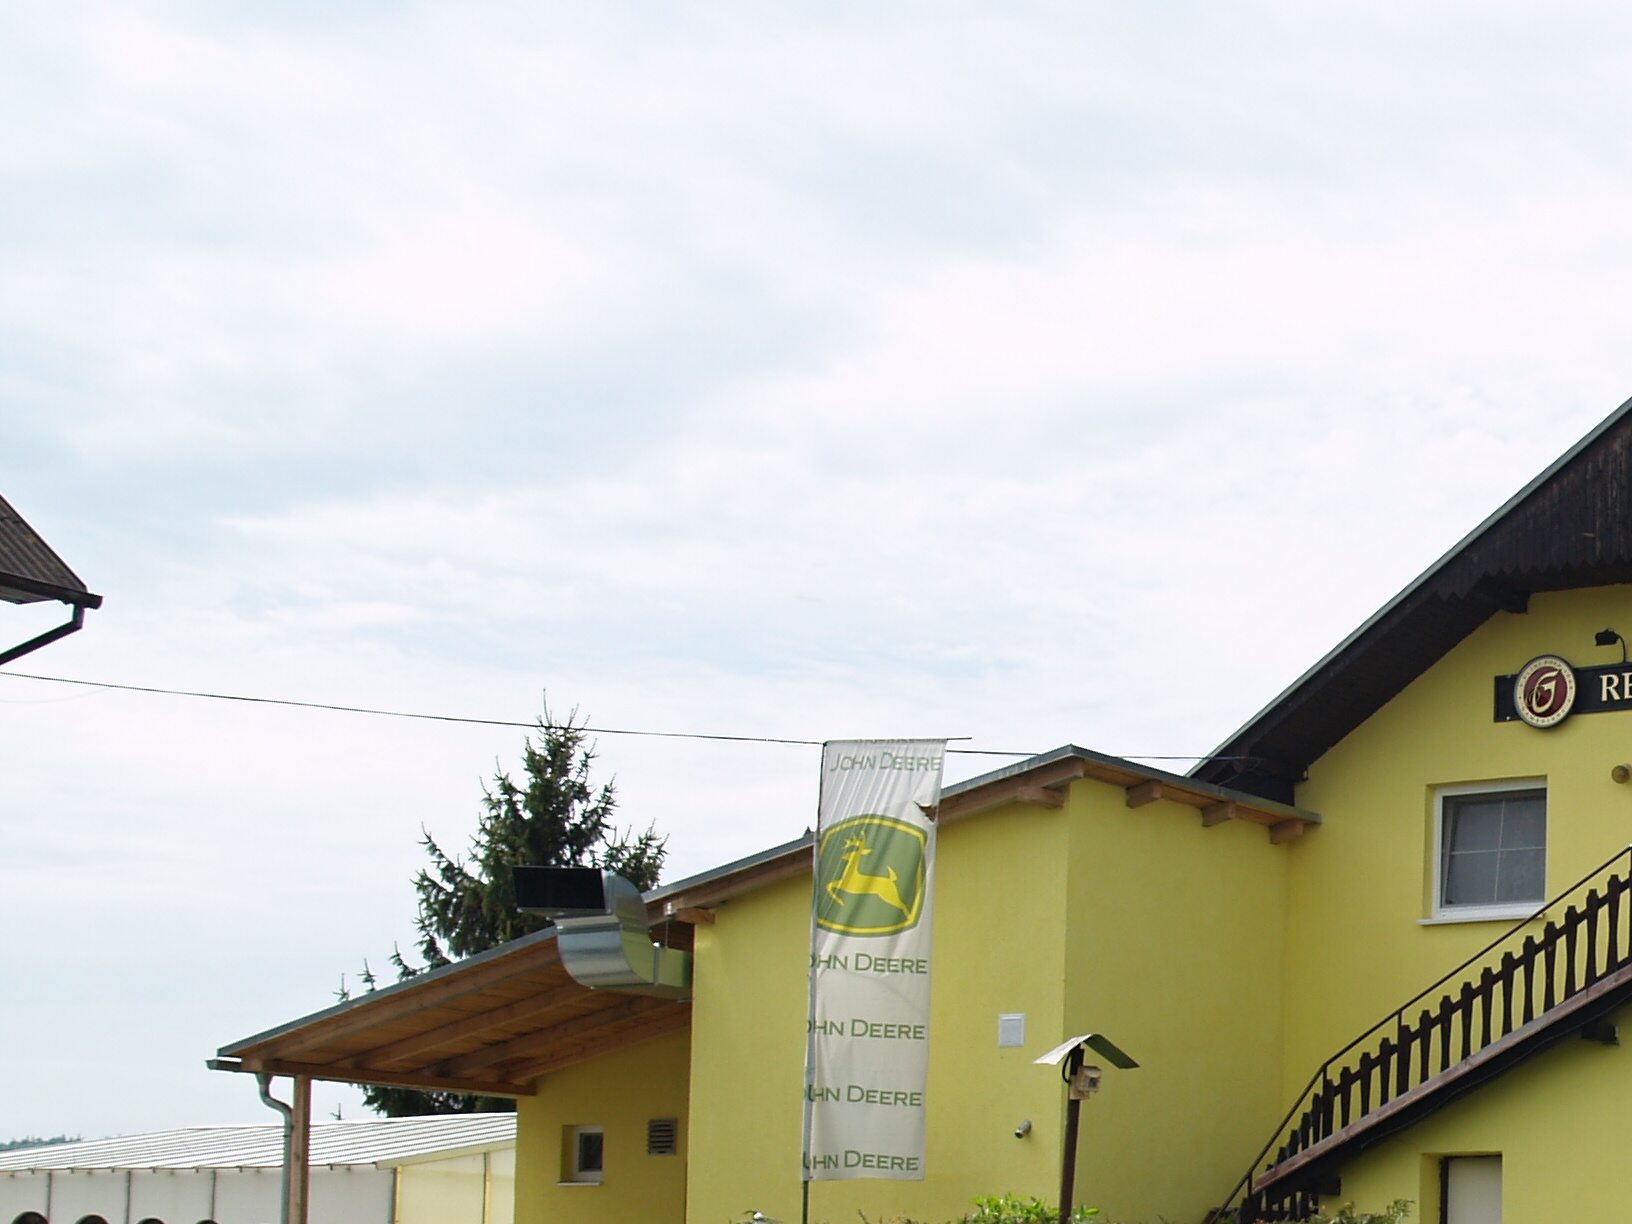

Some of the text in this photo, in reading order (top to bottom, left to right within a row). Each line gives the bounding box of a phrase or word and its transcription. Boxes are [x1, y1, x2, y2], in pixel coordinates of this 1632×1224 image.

[830, 751, 943, 772] JOHN DEERE
[855, 953, 927, 974] DEERE
[851, 1019, 925, 1040] DEERE
[847, 1085, 922, 1106] DEERE
[844, 1150, 919, 1171] DEERE
